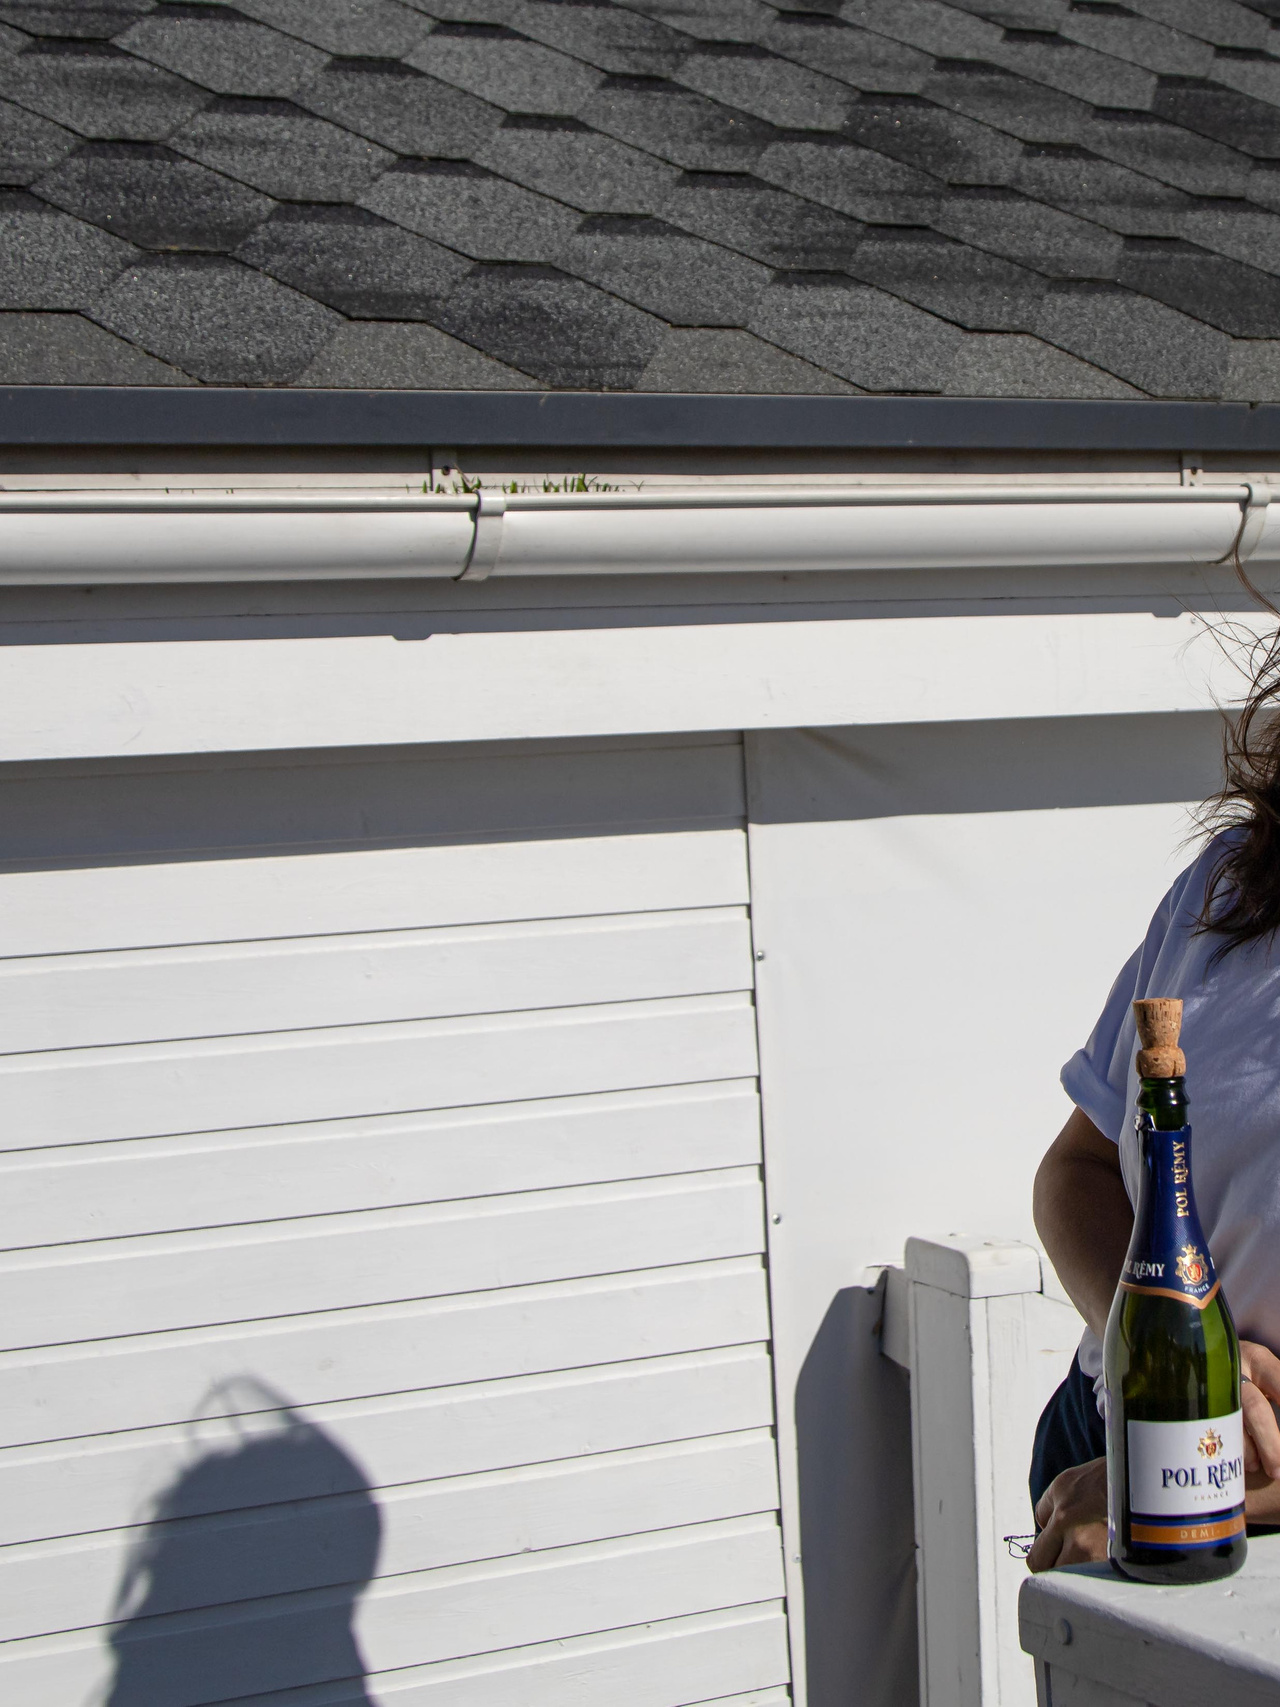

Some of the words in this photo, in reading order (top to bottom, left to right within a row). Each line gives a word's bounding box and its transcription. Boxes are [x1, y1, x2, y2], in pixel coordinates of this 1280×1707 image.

[1171, 1141, 1189, 1184] RÉMY
[1176, 1188, 1189, 1217] POL
[1132, 1260, 1165, 1279] RÉMY
[1184, 1283, 1210, 1294] FRANCE
[1161, 1467, 1202, 1489] POL
[1207, 1456, 1243, 1490] RÉMY
[1194, 1490, 1229, 1501] FRANCE
